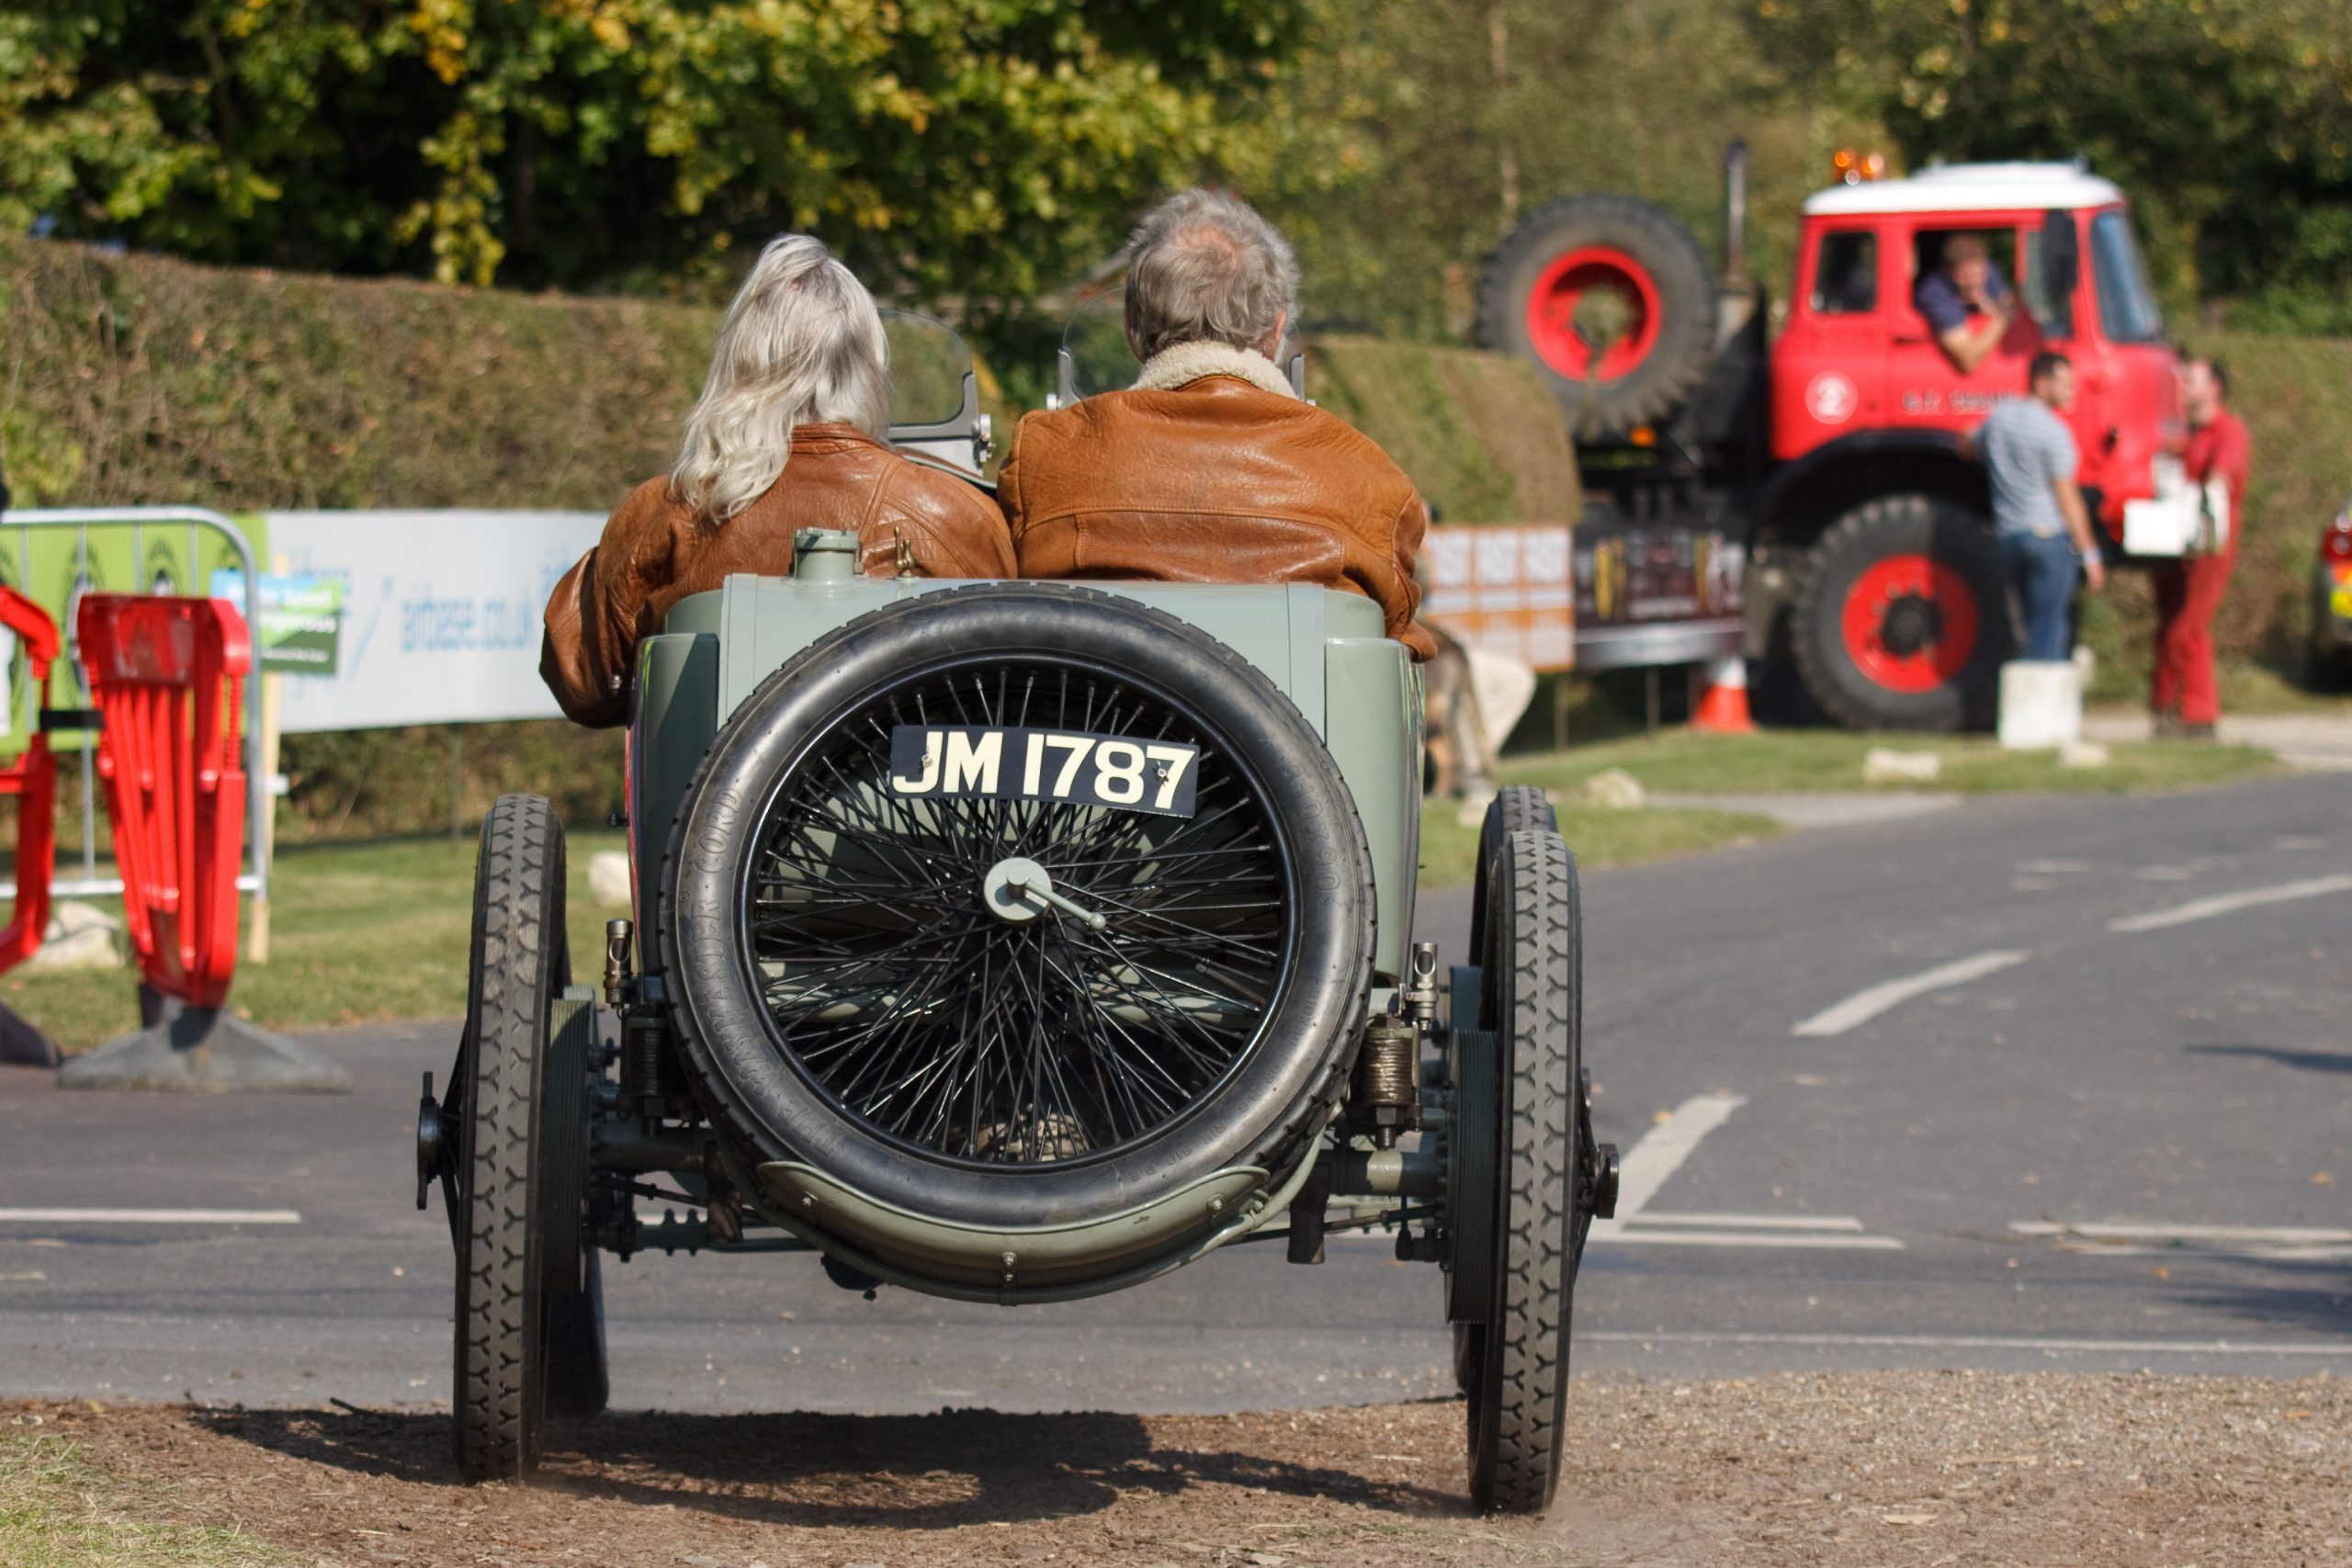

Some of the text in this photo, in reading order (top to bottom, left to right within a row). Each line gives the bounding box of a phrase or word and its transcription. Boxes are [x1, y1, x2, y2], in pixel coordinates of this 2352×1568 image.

[1816, 377, 1847, 416] 2
[892, 731, 1195, 810] JM 1787
[694, 788, 743, 874] CORD
[777, 1100, 846, 1157] THE
[1201, 1121, 1227, 1145] RIM
[1165, 1145, 1193, 1167] 810
